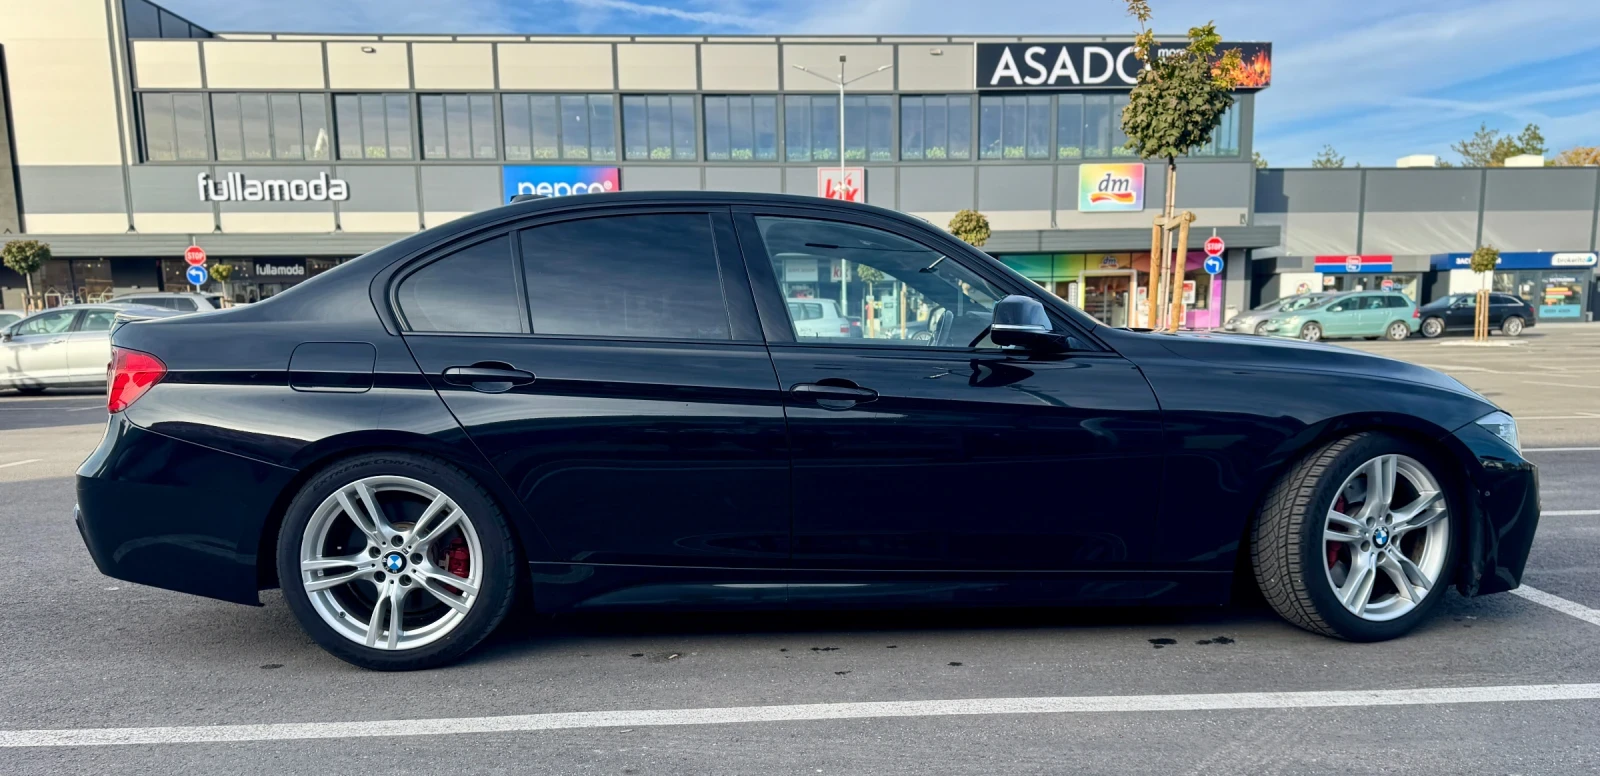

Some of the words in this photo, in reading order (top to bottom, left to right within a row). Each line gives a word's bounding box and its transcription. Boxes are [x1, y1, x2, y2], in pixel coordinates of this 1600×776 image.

[197, 172, 348, 202] fullamoda
[1098, 173, 1130, 193] dm
[1206, 242, 1223, 251] STOP
[187, 251, 205, 261] STOP
[256, 263, 305, 277] fullamoda
